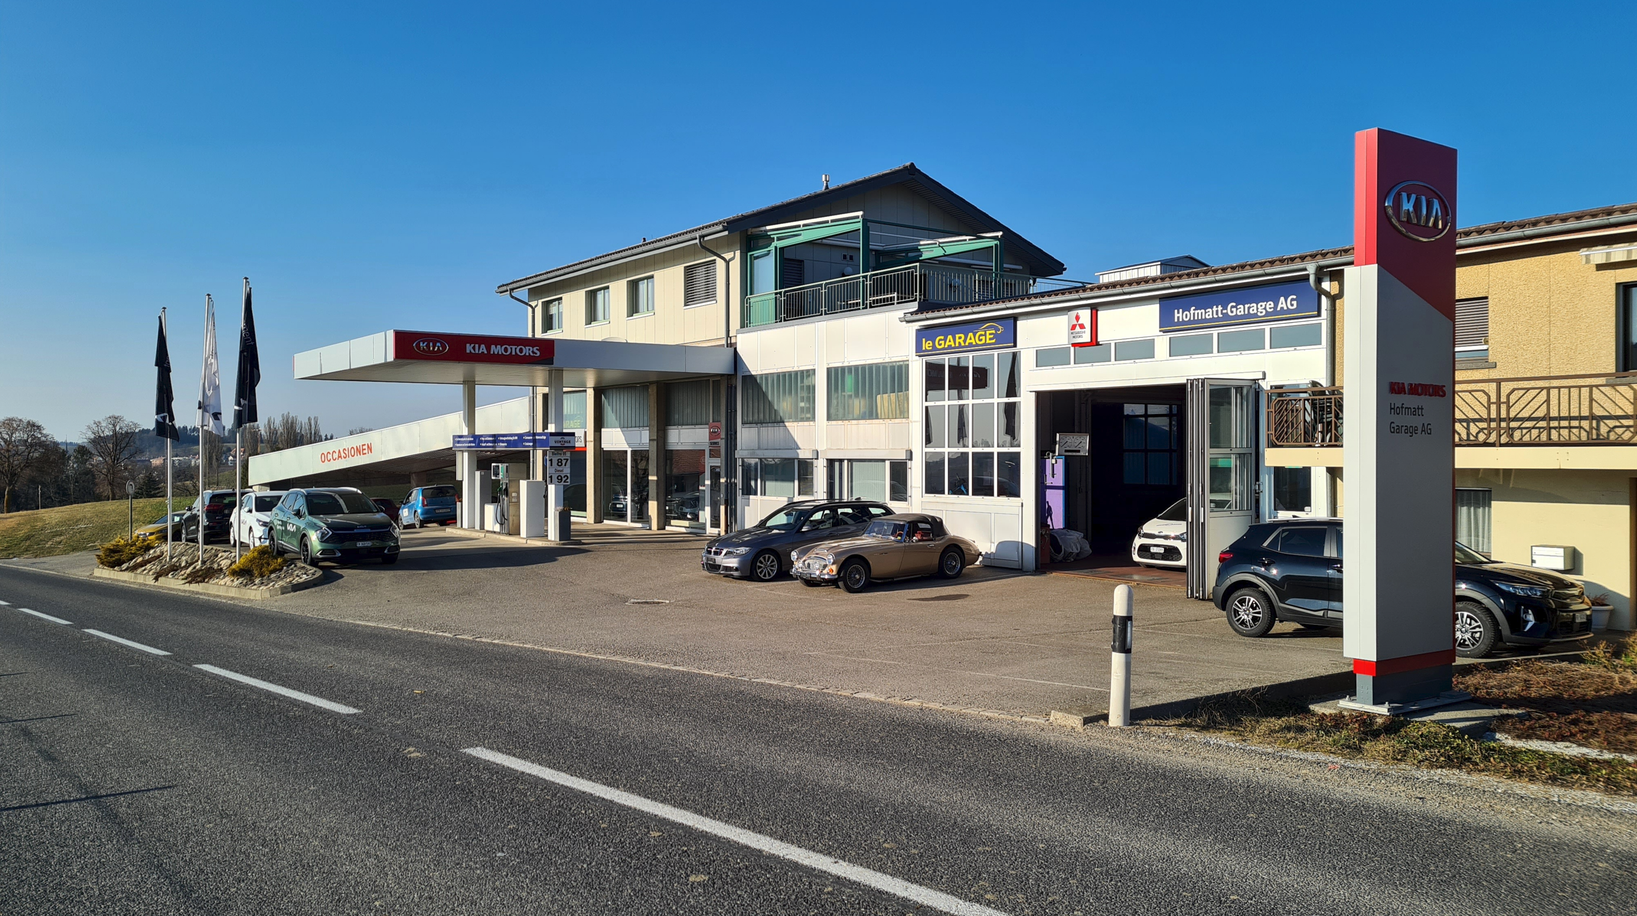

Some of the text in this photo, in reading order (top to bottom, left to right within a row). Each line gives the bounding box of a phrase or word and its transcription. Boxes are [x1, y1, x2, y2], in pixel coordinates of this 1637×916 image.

[1398, 191, 1443, 230] KIA
[1174, 295, 1298, 323] Hofmatt-Garage AG
[922, 329, 997, 350] le GARAGE
[465, 343, 541, 357] KIA MOTORS
[1389, 381, 1447, 398] KIA MOTORS
[1389, 402, 1425, 417] Hofmatt
[1389, 421, 1432, 438] Garage AG
[320, 442, 373, 464] OCCASIONEN
[556, 458, 569, 466] 87
[556, 475, 569, 484] 92
